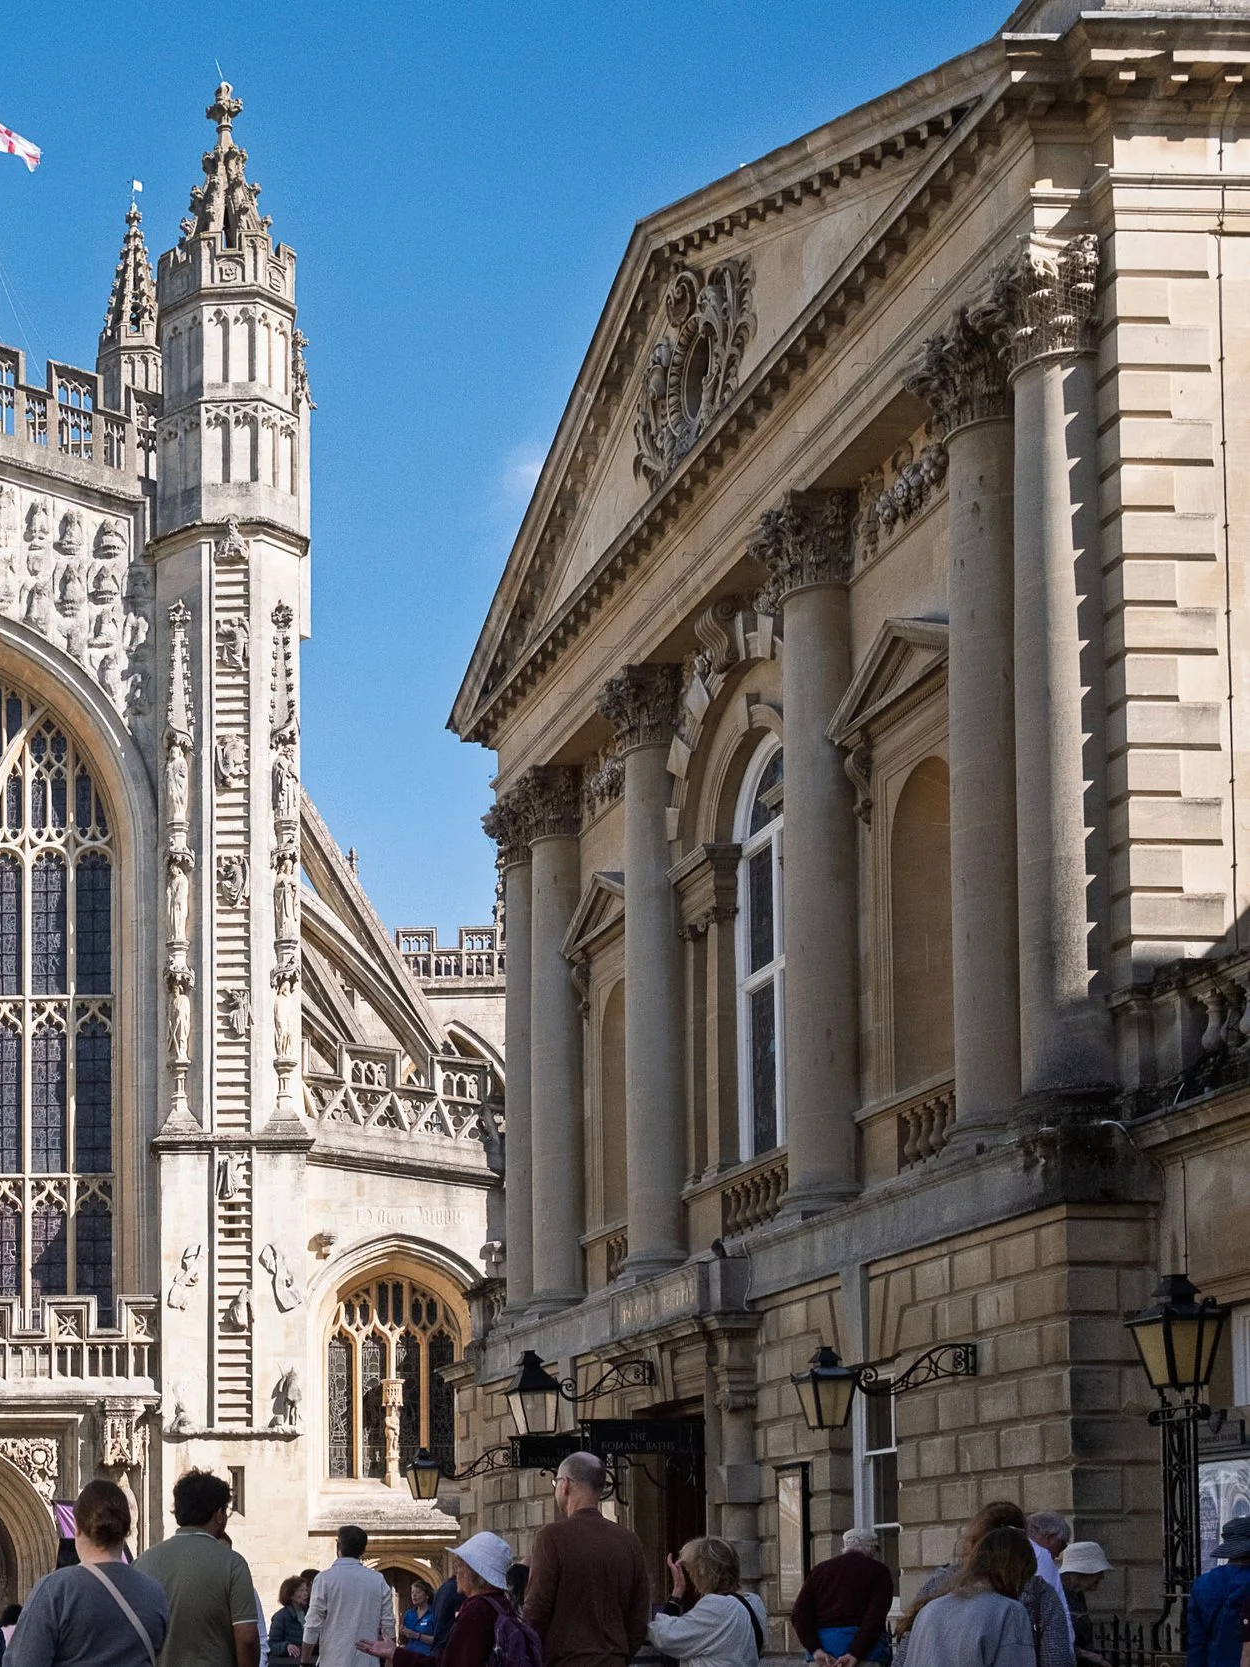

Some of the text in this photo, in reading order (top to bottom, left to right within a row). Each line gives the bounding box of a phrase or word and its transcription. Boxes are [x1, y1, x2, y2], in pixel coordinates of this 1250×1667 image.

[630, 1432, 647, 1441] THE
[601, 1441, 675, 1450] ROMAN BATHS
